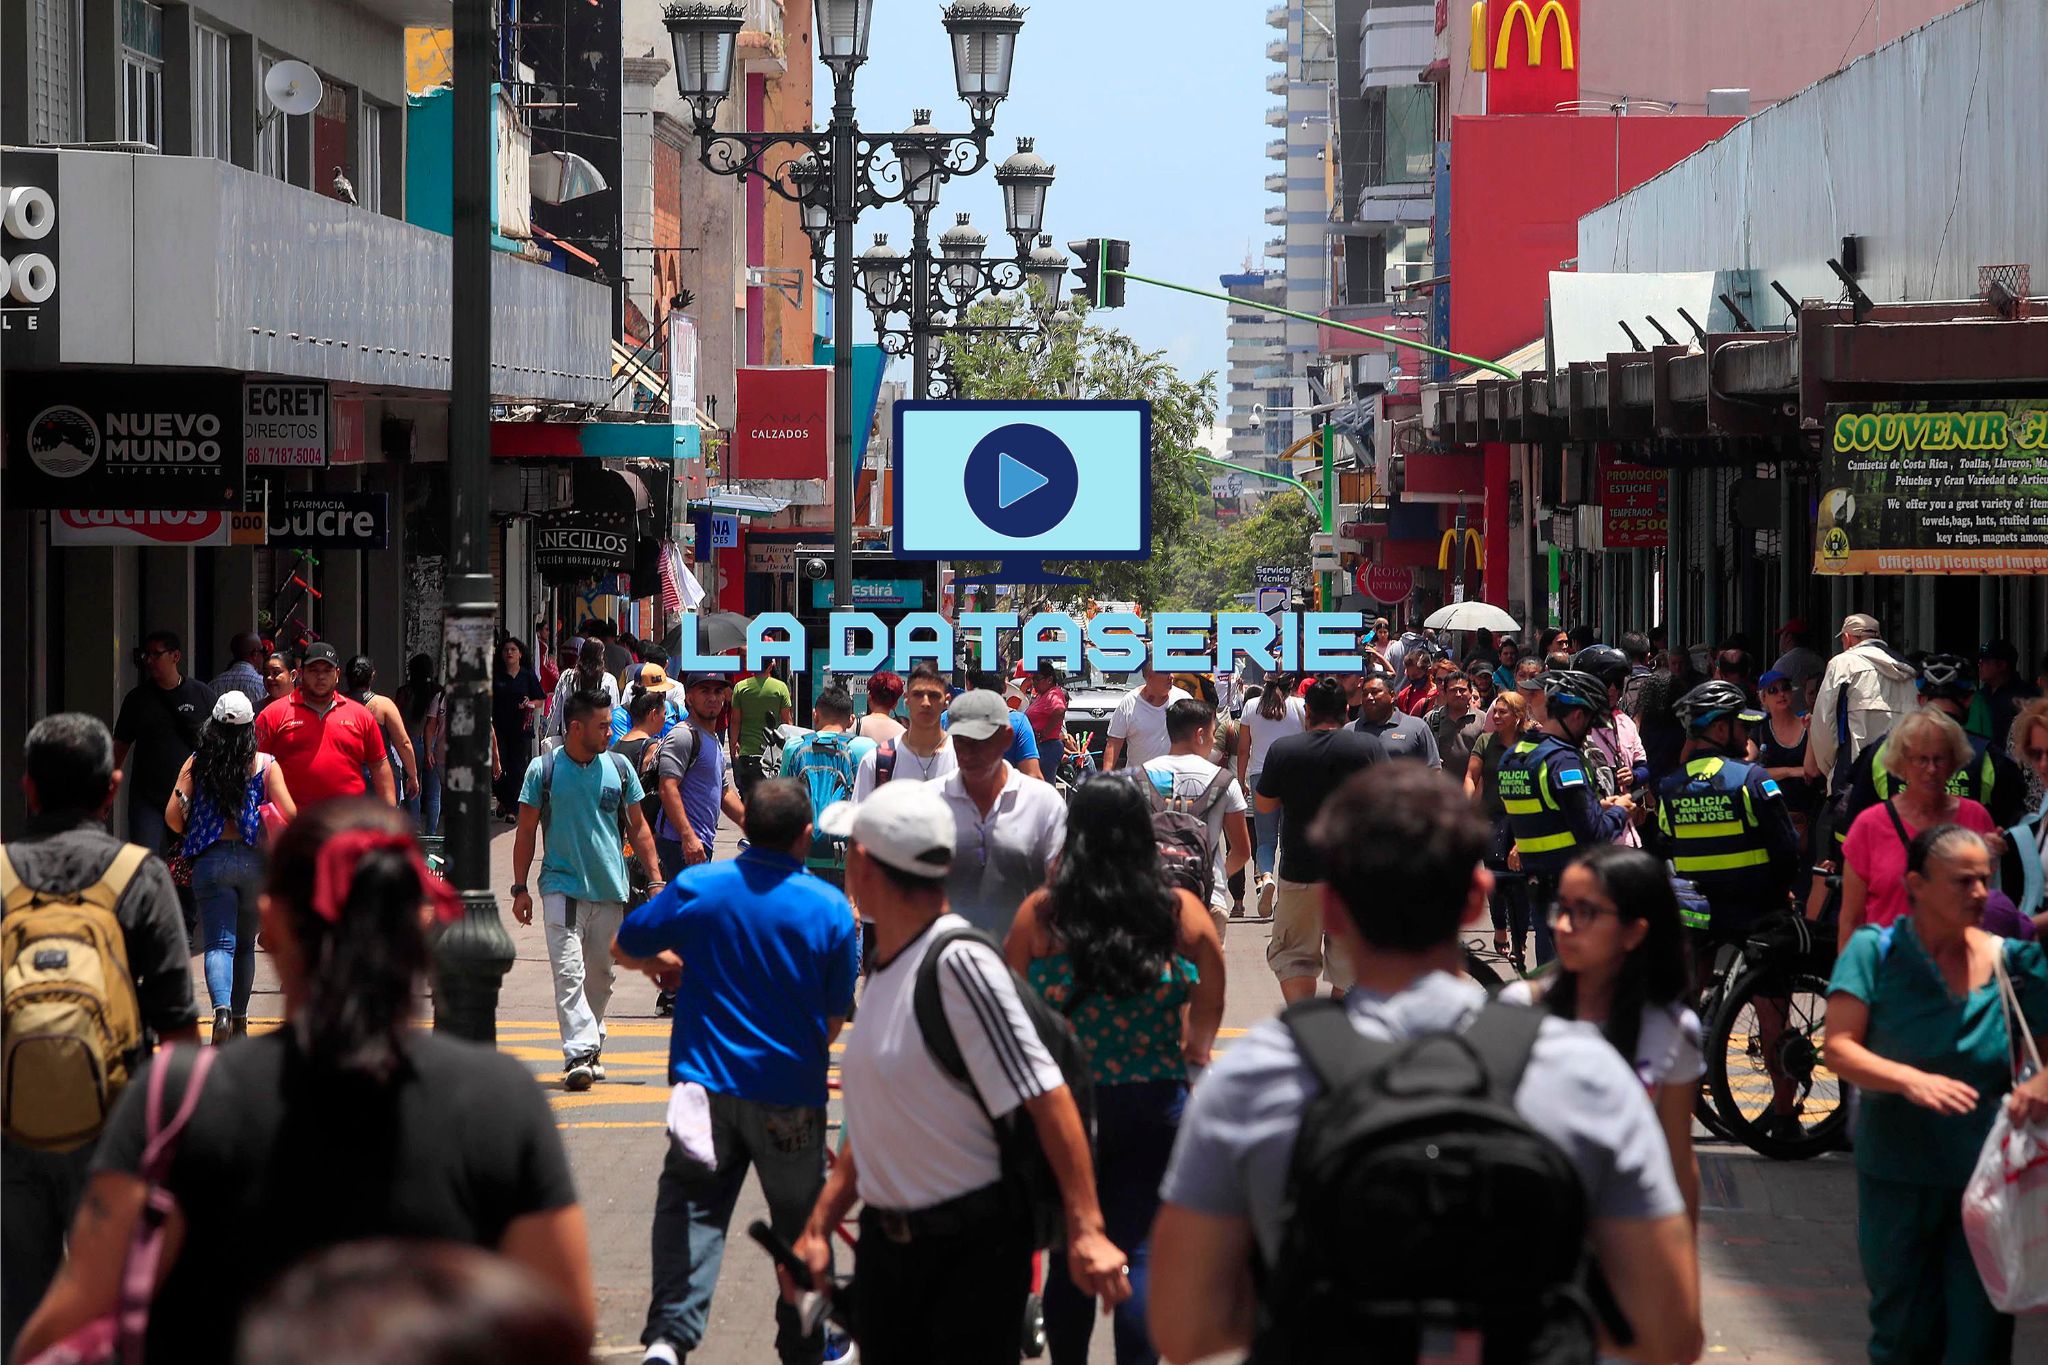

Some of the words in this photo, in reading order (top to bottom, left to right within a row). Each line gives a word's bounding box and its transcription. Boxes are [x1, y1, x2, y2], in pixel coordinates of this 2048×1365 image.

[246, 387, 323, 416] ECRET
[106, 413, 221, 437] NUEVO
[751, 429, 809, 439] CALZADOS
[1834, 411, 2008, 452] SOUVENIR
[106, 440, 221, 462] MUNDO
[246, 448, 260, 464] 68
[268, 448, 322, 464] 7187-5004
[1847, 460, 1888, 471] Camisetas
[1890, 459, 1900, 469] de
[1902, 459, 1926, 470] Costa
[1960, 458, 1992, 470] Toallas,
[1994, 458, 2033, 469] Llaveros,
[2035, 457, 2048, 469] Ma
[1606, 470, 1669, 481] PROMOCION
[1895, 476, 1933, 486] Peluches
[1935, 478, 1942, 487] y
[1944, 476, 1965, 486] Gran
[1967, 475, 2006, 486] Variedad
[2008, 475, 2019, 485] de
[1610, 484, 1652, 493] ESTUCHE
[293, 501, 345, 510] FARMACIA
[1887, 499, 1901, 510] We
[1905, 498, 1927, 510] offer
[1929, 501, 1947, 512] you
[1948, 502, 1954, 510] a
[1956, 500, 1979, 512] great
[1981, 498, 2013, 511] variety
[2014, 498, 2025, 509] of
[1609, 507, 1653, 517] TEMPERADO
[1976, 515, 1997, 527] hats,
[1999, 514, 2030, 526] stuffed
[1936, 533, 1952, 545] key
[1954, 533, 1981, 545] rings,
[1982, 533, 2018, 545] magnets
[1878, 555, 1940, 571] Officially
[1943, 555, 2003, 570] licensed
[1256, 566, 1291, 574] Servicio
[1374, 567, 1406, 577] ROPA
[1257, 573, 1290, 583] Técnico
[852, 584, 893, 597] Estirá
[1498, 770, 1530, 780] POLICIA
[1511, 785, 1531, 795] JOSE
[1671, 795, 1732, 808] POLICIA
[1679, 805, 1726, 814] MUNICIPAL
[1674, 814, 1698, 824] SAN
[1700, 810, 1734, 822] JOSE
